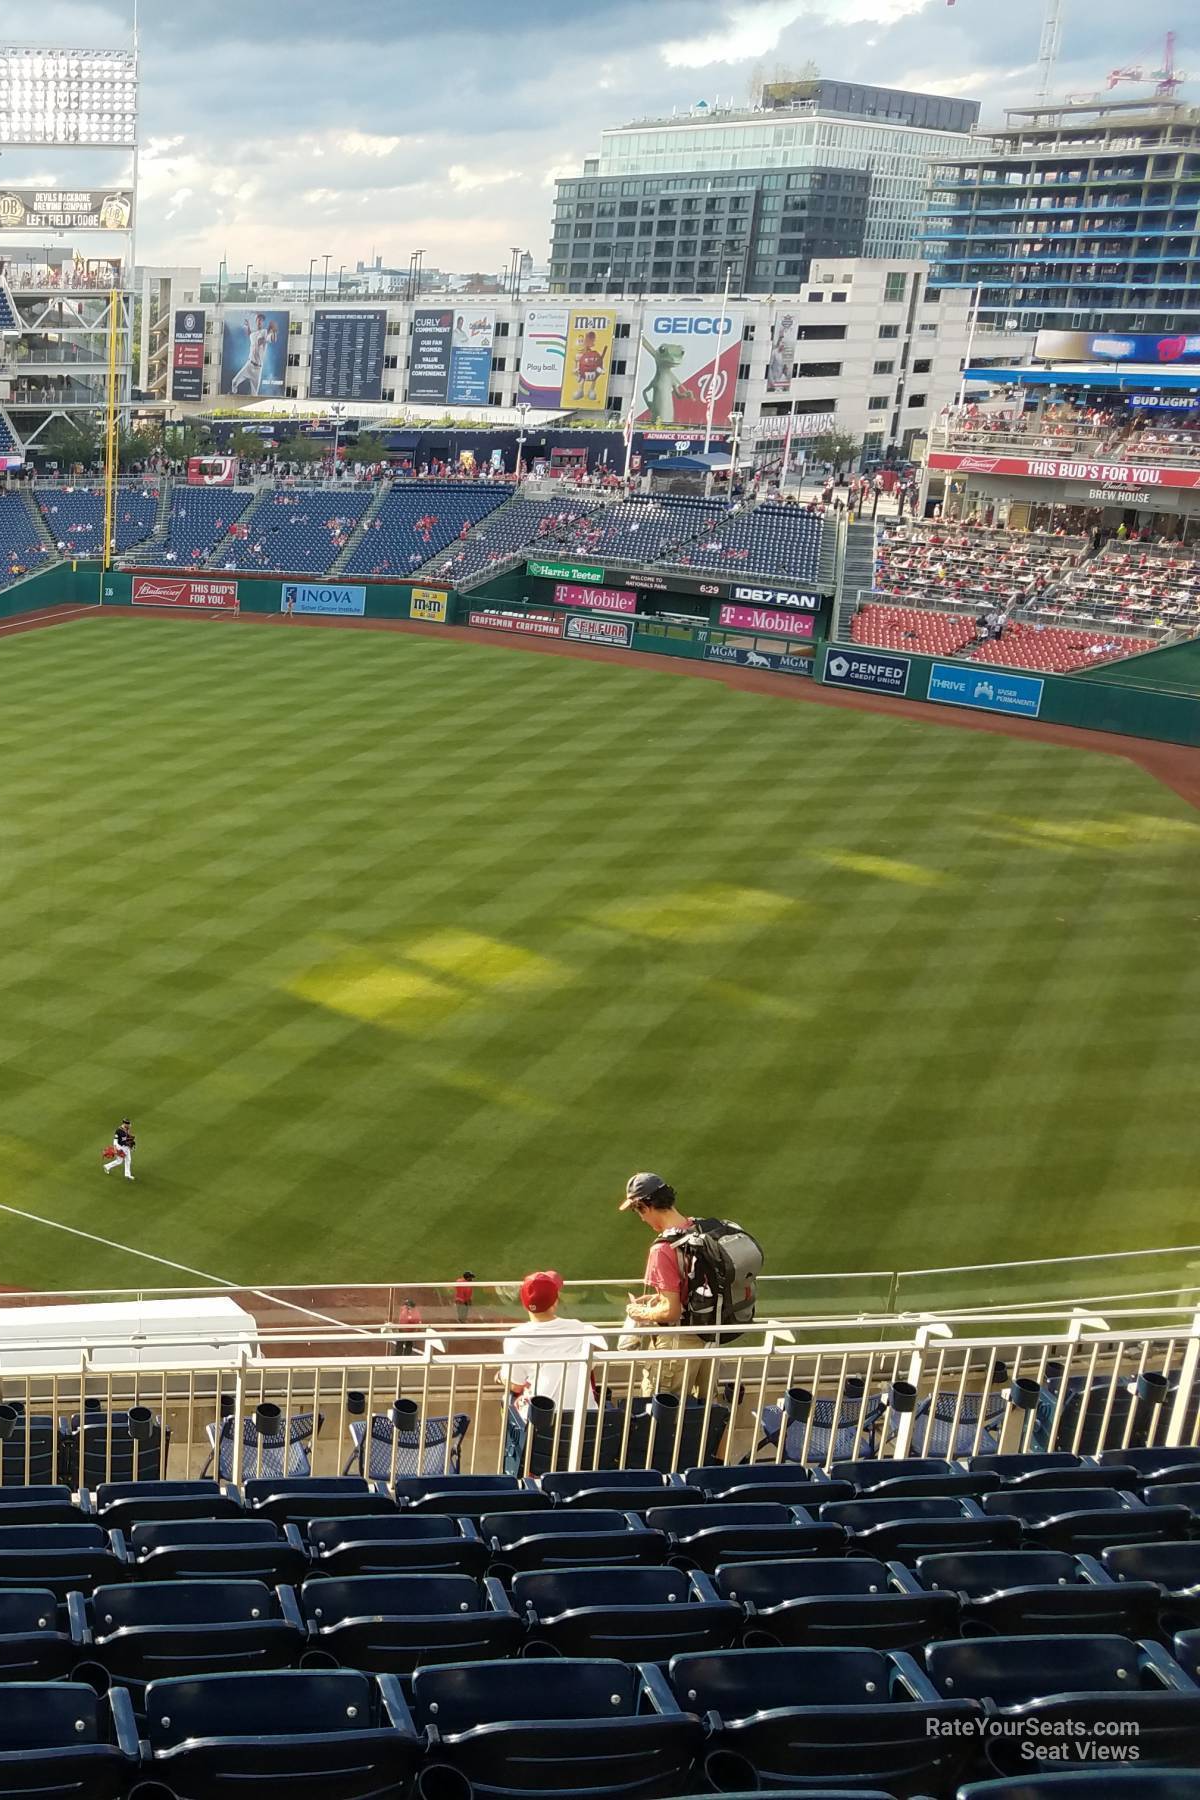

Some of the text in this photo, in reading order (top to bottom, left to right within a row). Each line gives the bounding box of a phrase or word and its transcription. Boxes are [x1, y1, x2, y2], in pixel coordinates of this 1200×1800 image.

[36, 193, 90, 202] DEVILS BACKBONE
[33, 202, 92, 211] BREWING COMPANY
[26, 214, 99, 226] LEFT FIELD LODGE
[415, 319, 441, 327] CURLY
[654, 317, 732, 335] GEICO
[526, 364, 542, 372] Play
[1132, 396, 1195, 407] BUD LIGHT
[1027, 462, 1056, 476] THIS
[1059, 463, 1099, 478] BUD'S
[1102, 466, 1128, 481] FOR
[1132, 468, 1162, 484] YOU.
[1089, 489, 1150, 504] BREW HOUSE
[540, 566, 601, 580] Harris Teeter
[630, 574, 654, 582] WELCOME
[190, 584, 235, 595] THIS BUD'S
[625, 580, 653, 588] NATIONALS
[700, 584, 720, 594] 6:29
[140, 586, 180, 596] Budweiser
[301, 590, 352, 604] INOVA
[190, 594, 226, 604] FOR YOU.
[776, 592, 816, 608] FAN
[471, 615, 560, 635] CRAFTSMAN CRAFTSMAN
[710, 646, 737, 658] MGM
[780, 656, 808, 669] MGM
[851, 662, 903, 678] PENFED
[850, 672, 900, 686] CREDIT UNION
[932, 678, 966, 692] THRIVE
